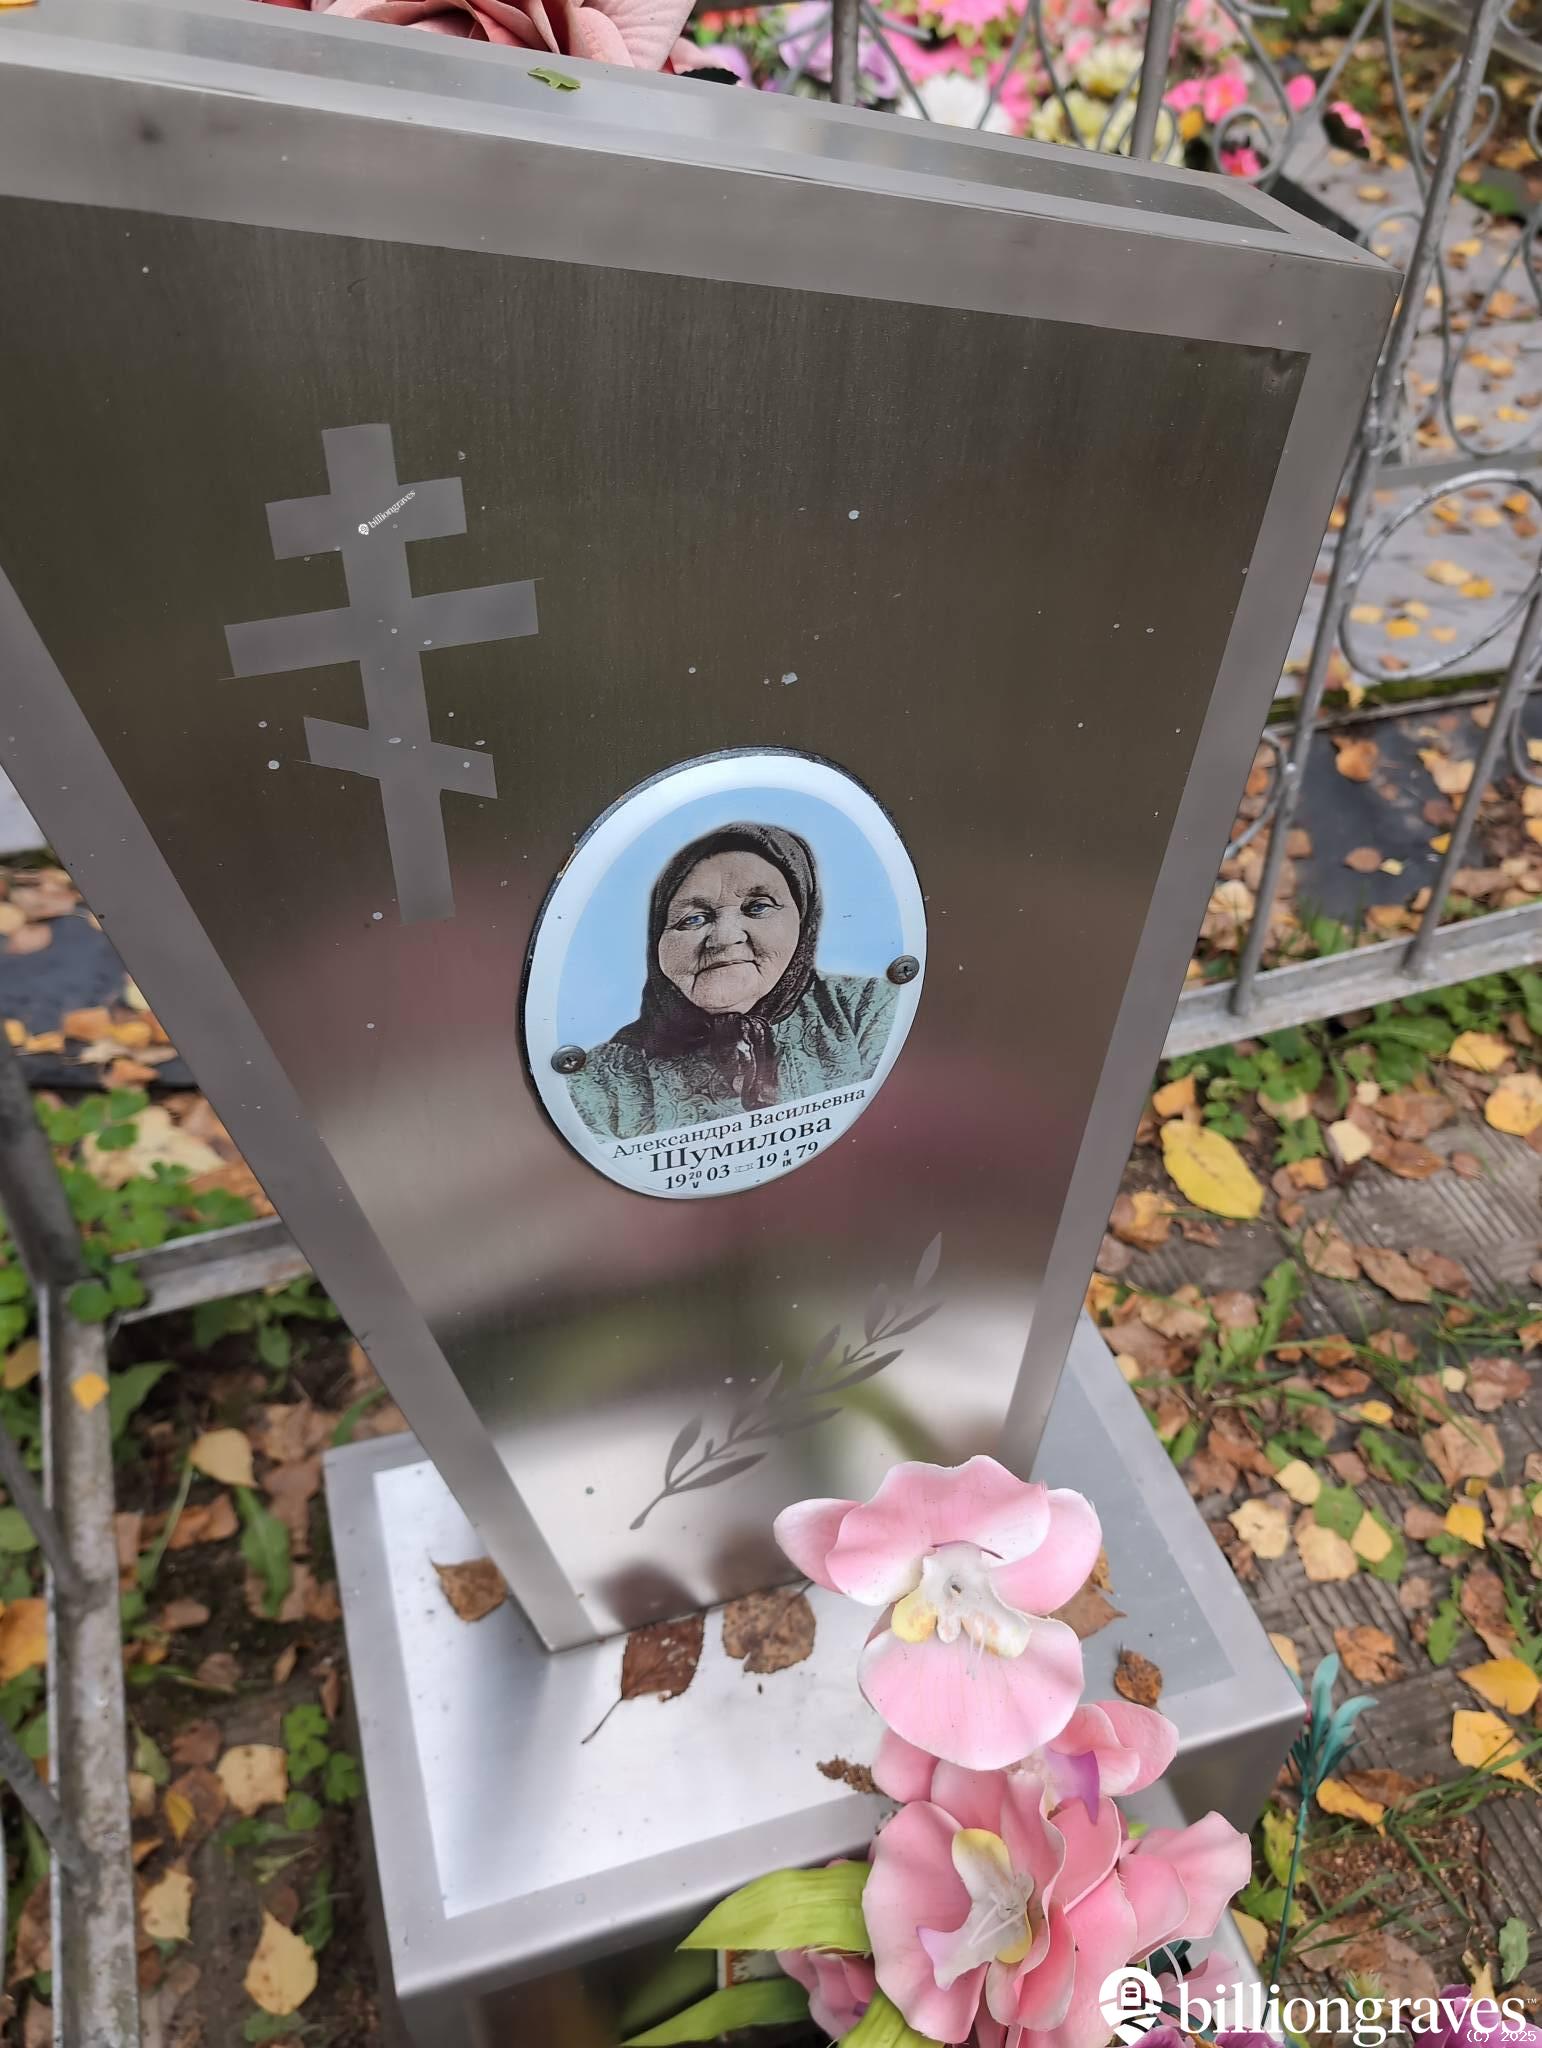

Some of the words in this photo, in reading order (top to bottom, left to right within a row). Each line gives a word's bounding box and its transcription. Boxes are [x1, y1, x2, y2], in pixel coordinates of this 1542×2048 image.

[613, 1121, 743, 1159] Александра
[748, 1088, 866, 1129] Васильевна
[649, 1116, 832, 1172] Шумилова
